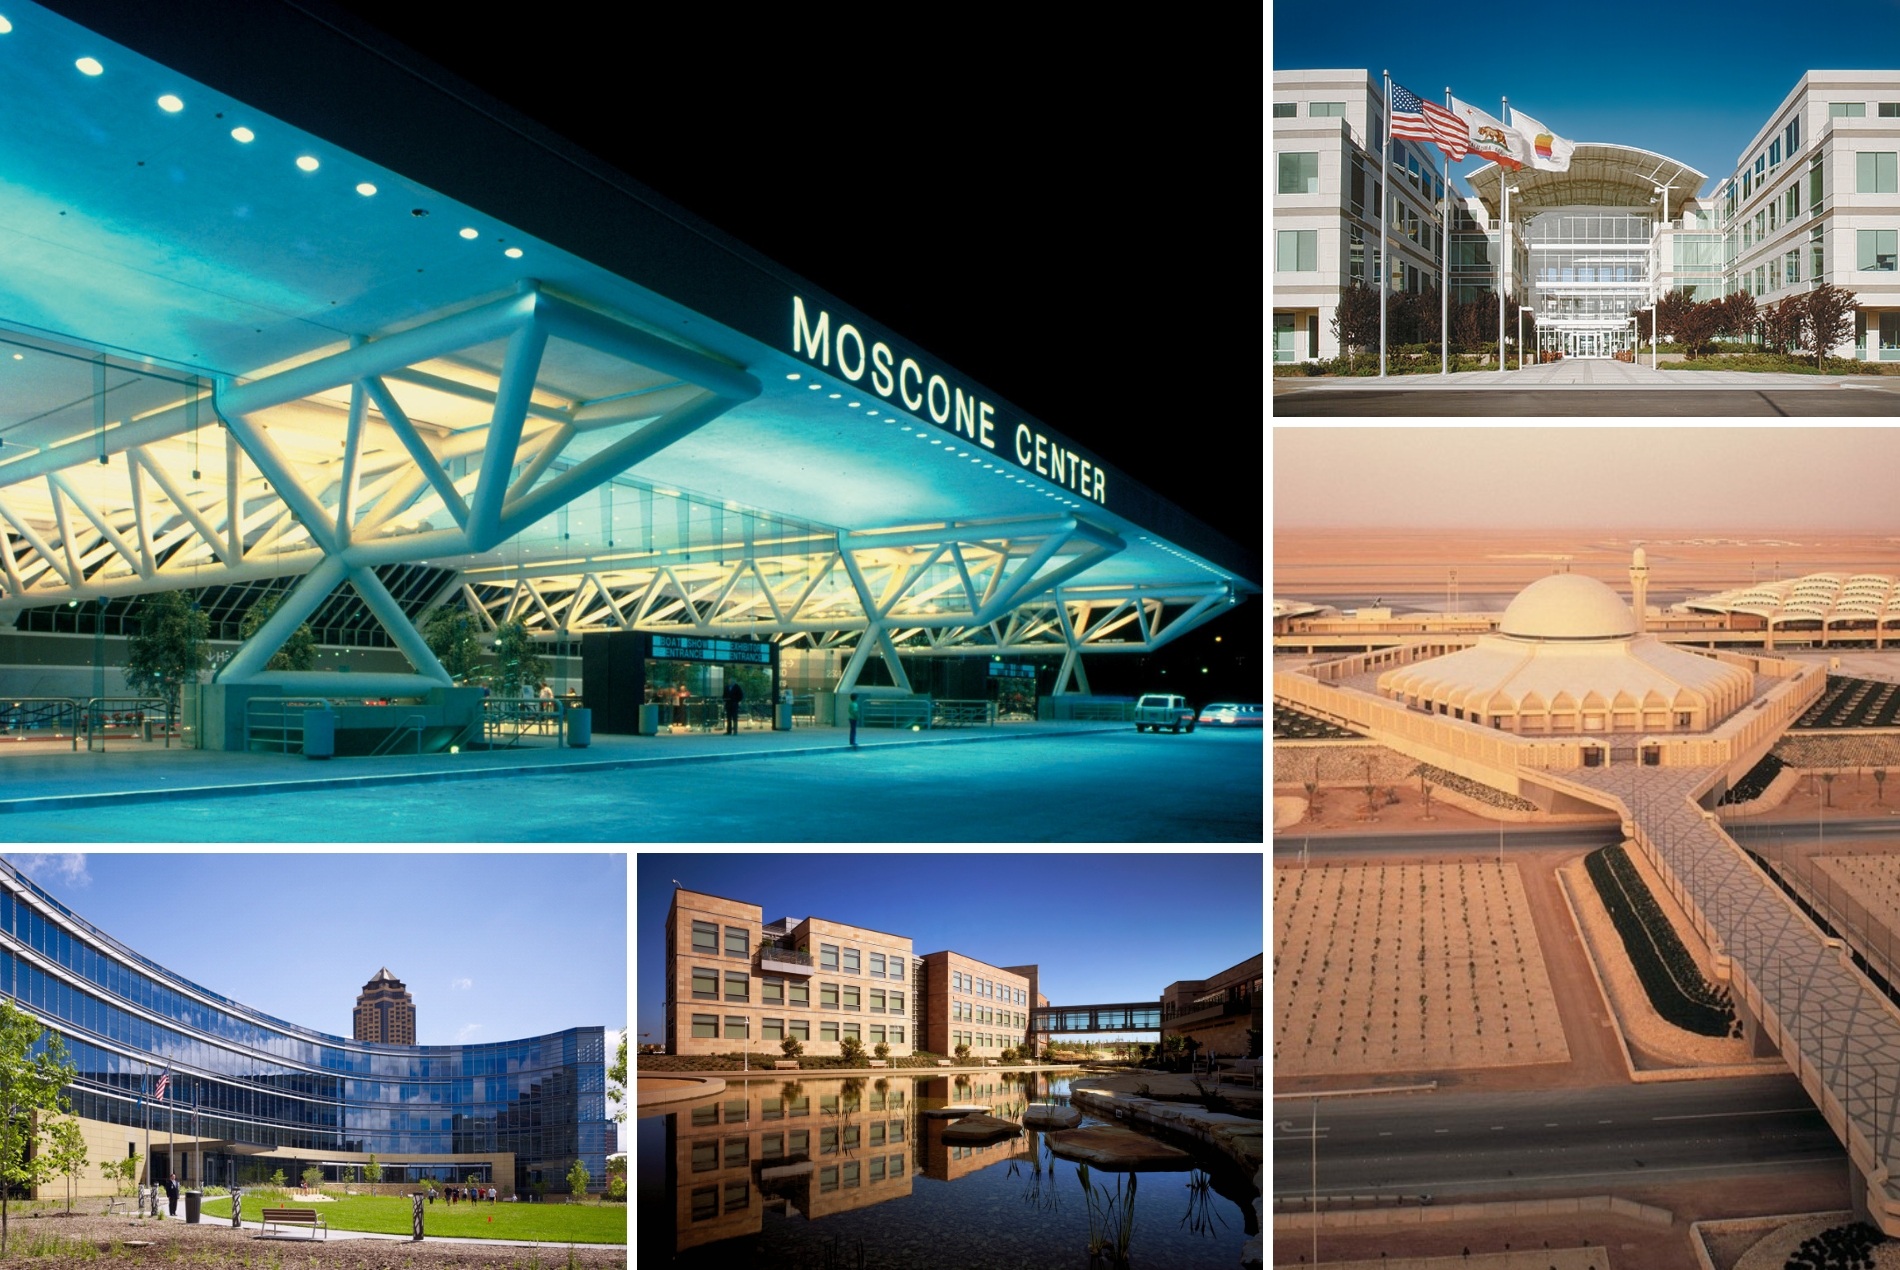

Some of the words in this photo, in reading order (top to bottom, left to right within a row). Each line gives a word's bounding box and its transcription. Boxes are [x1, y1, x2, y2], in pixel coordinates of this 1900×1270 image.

[793, 295, 996, 449] MOSCONE
[1015, 423, 1106, 504] CENTER
[660, 636, 682, 647] BOAT
[687, 638, 709, 649] SHOW
[730, 642, 761, 653] EXHIBITOR
[665, 648, 703, 659] ENTRANCE
[730, 651, 762, 661] ENTRANCE
